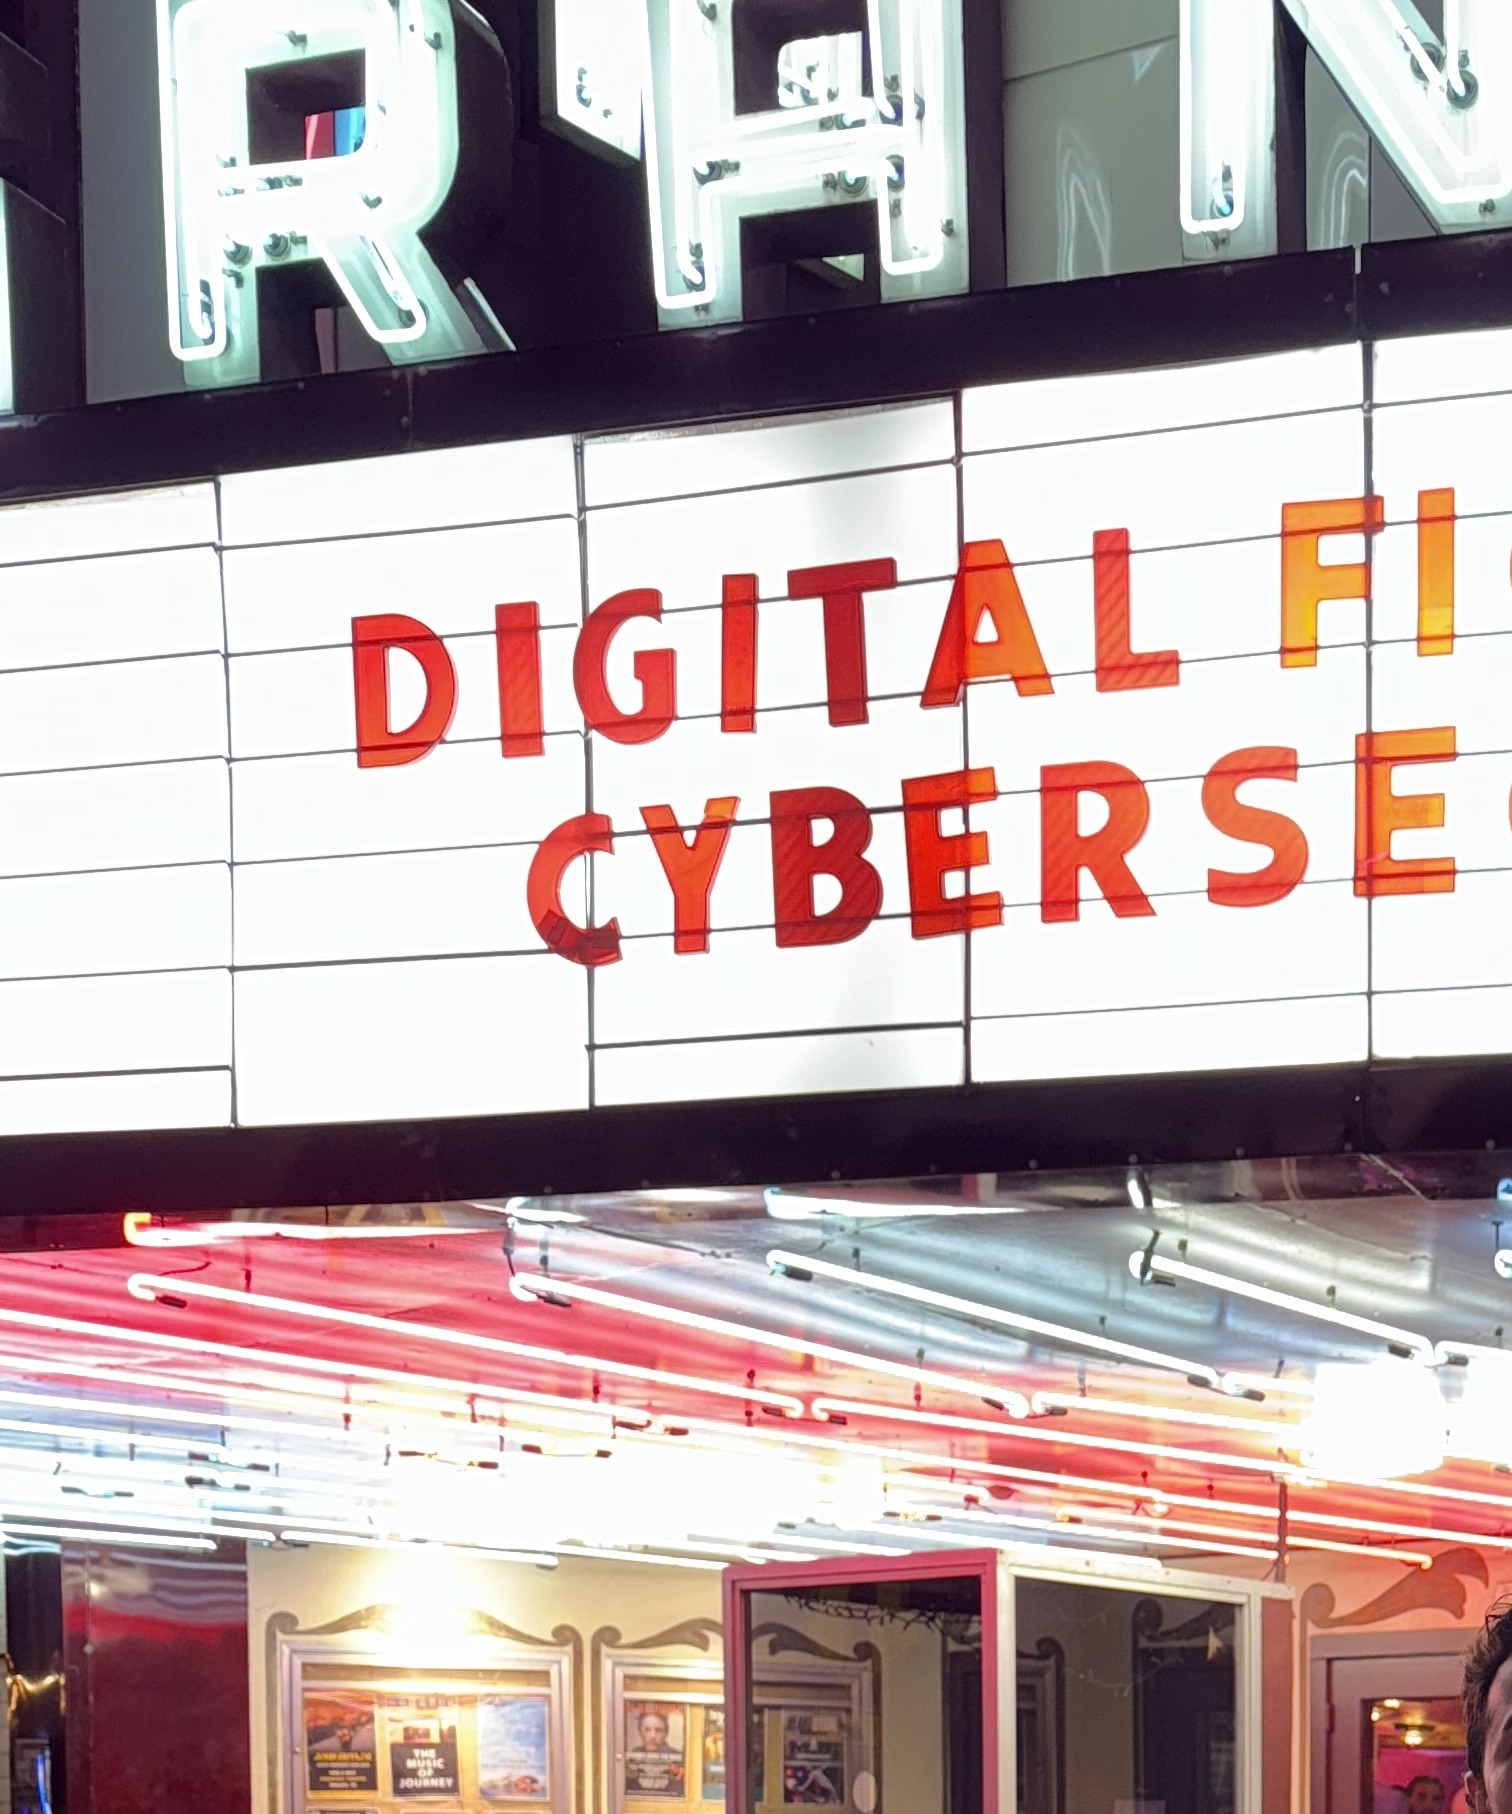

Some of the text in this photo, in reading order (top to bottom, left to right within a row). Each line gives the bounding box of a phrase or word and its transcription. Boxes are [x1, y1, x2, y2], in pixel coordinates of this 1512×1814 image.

[350, 528, 1181, 768] DIGITAL
[413, 1748, 436, 1758] THE
[406, 1758, 445, 1769] MUSIC
[417, 1768, 434, 1777] OF
[399, 1777, 454, 1789] JOURNEY
